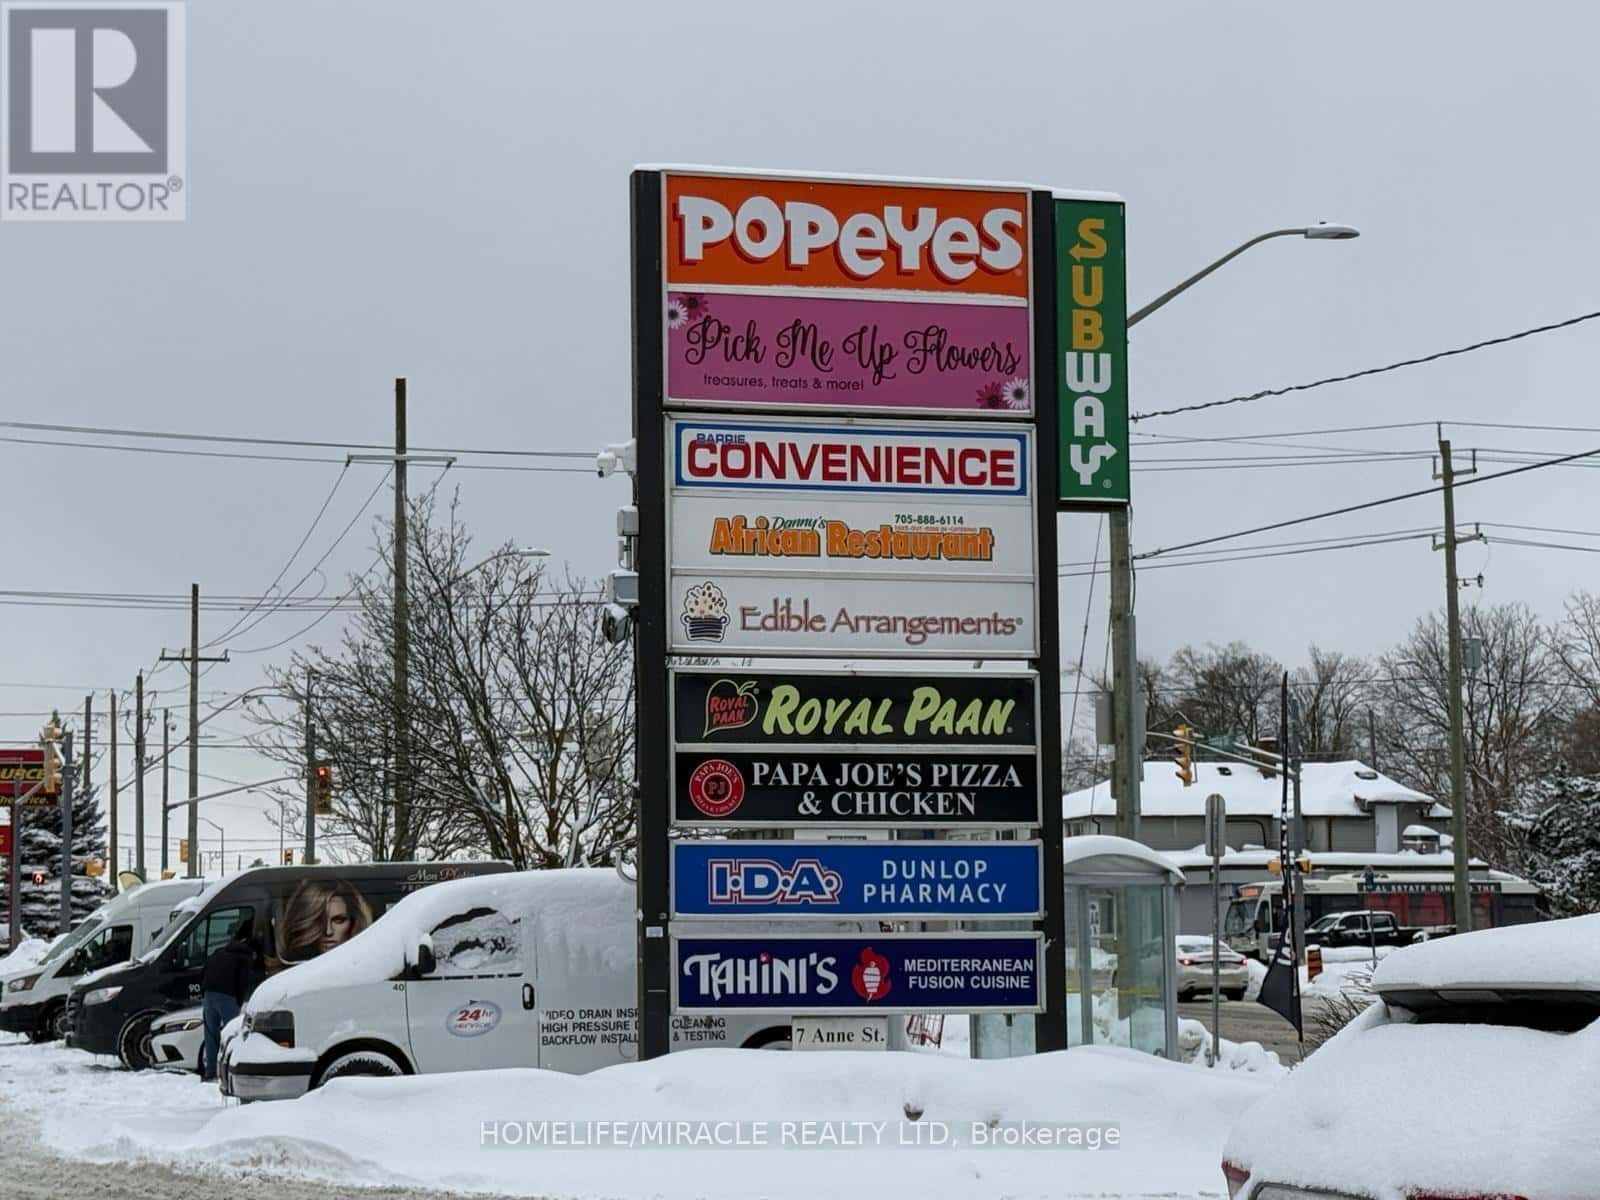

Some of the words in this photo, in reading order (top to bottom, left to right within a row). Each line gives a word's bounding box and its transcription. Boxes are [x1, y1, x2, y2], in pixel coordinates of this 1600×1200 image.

[685, 315, 766, 365] Pick
[775, 319, 834, 373] Me
[842, 325, 898, 386] Up
[903, 325, 1021, 376] Flowers
[1065, 217, 1118, 487] SUBWAY
[703, 376, 767, 390] treasures,
[771, 377, 808, 389] treats
[812, 378, 822, 389] &
[826, 379, 864, 391] more!
[696, 432, 745, 445] BARRIE
[688, 439, 1016, 486] CONVENIENCE
[771, 516, 826, 531] Danny's
[895, 514, 964, 525] 705-888-6114
[709, 515, 821, 557] African
[826, 520, 995, 561] Restaurant
[739, 597, 826, 633] Edible
[831, 608, 1018, 645] Arrangements
[710, 695, 749, 713] ROYAL
[762, 684, 894, 736] ROYAL
[904, 686, 1016, 736] PAAN
[752, 762, 835, 788] PAPA
[836, 763, 923, 788] JOE'S
[930, 764, 1023, 788] PIZZA
[798, 791, 823, 816] &
[831, 792, 976, 817] CHICKEN
[882, 860, 988, 880] DUNLOP
[863, 883, 1008, 904] PHARMACY
[904, 958, 1034, 973] MEDITERRANEAN
[909, 976, 965, 989] FUSION
[970, 976, 1031, 989] CUISINE
[456, 1008, 481, 1021] 24
[578, 1009, 612, 1019] DRAIN
[541, 1022, 568, 1033] HIGH
[572, 1020, 630, 1032] PRESSURE
[671, 1016, 726, 1029] CLEANING
[541, 1034, 597, 1046] BACKFLOW
[672, 1031, 681, 1042] &
[684, 1030, 726, 1042] TESTING
[796, 1028, 805, 1044] 7
[812, 1028, 854, 1043] Anne
[861, 1026, 885, 1043] St.
